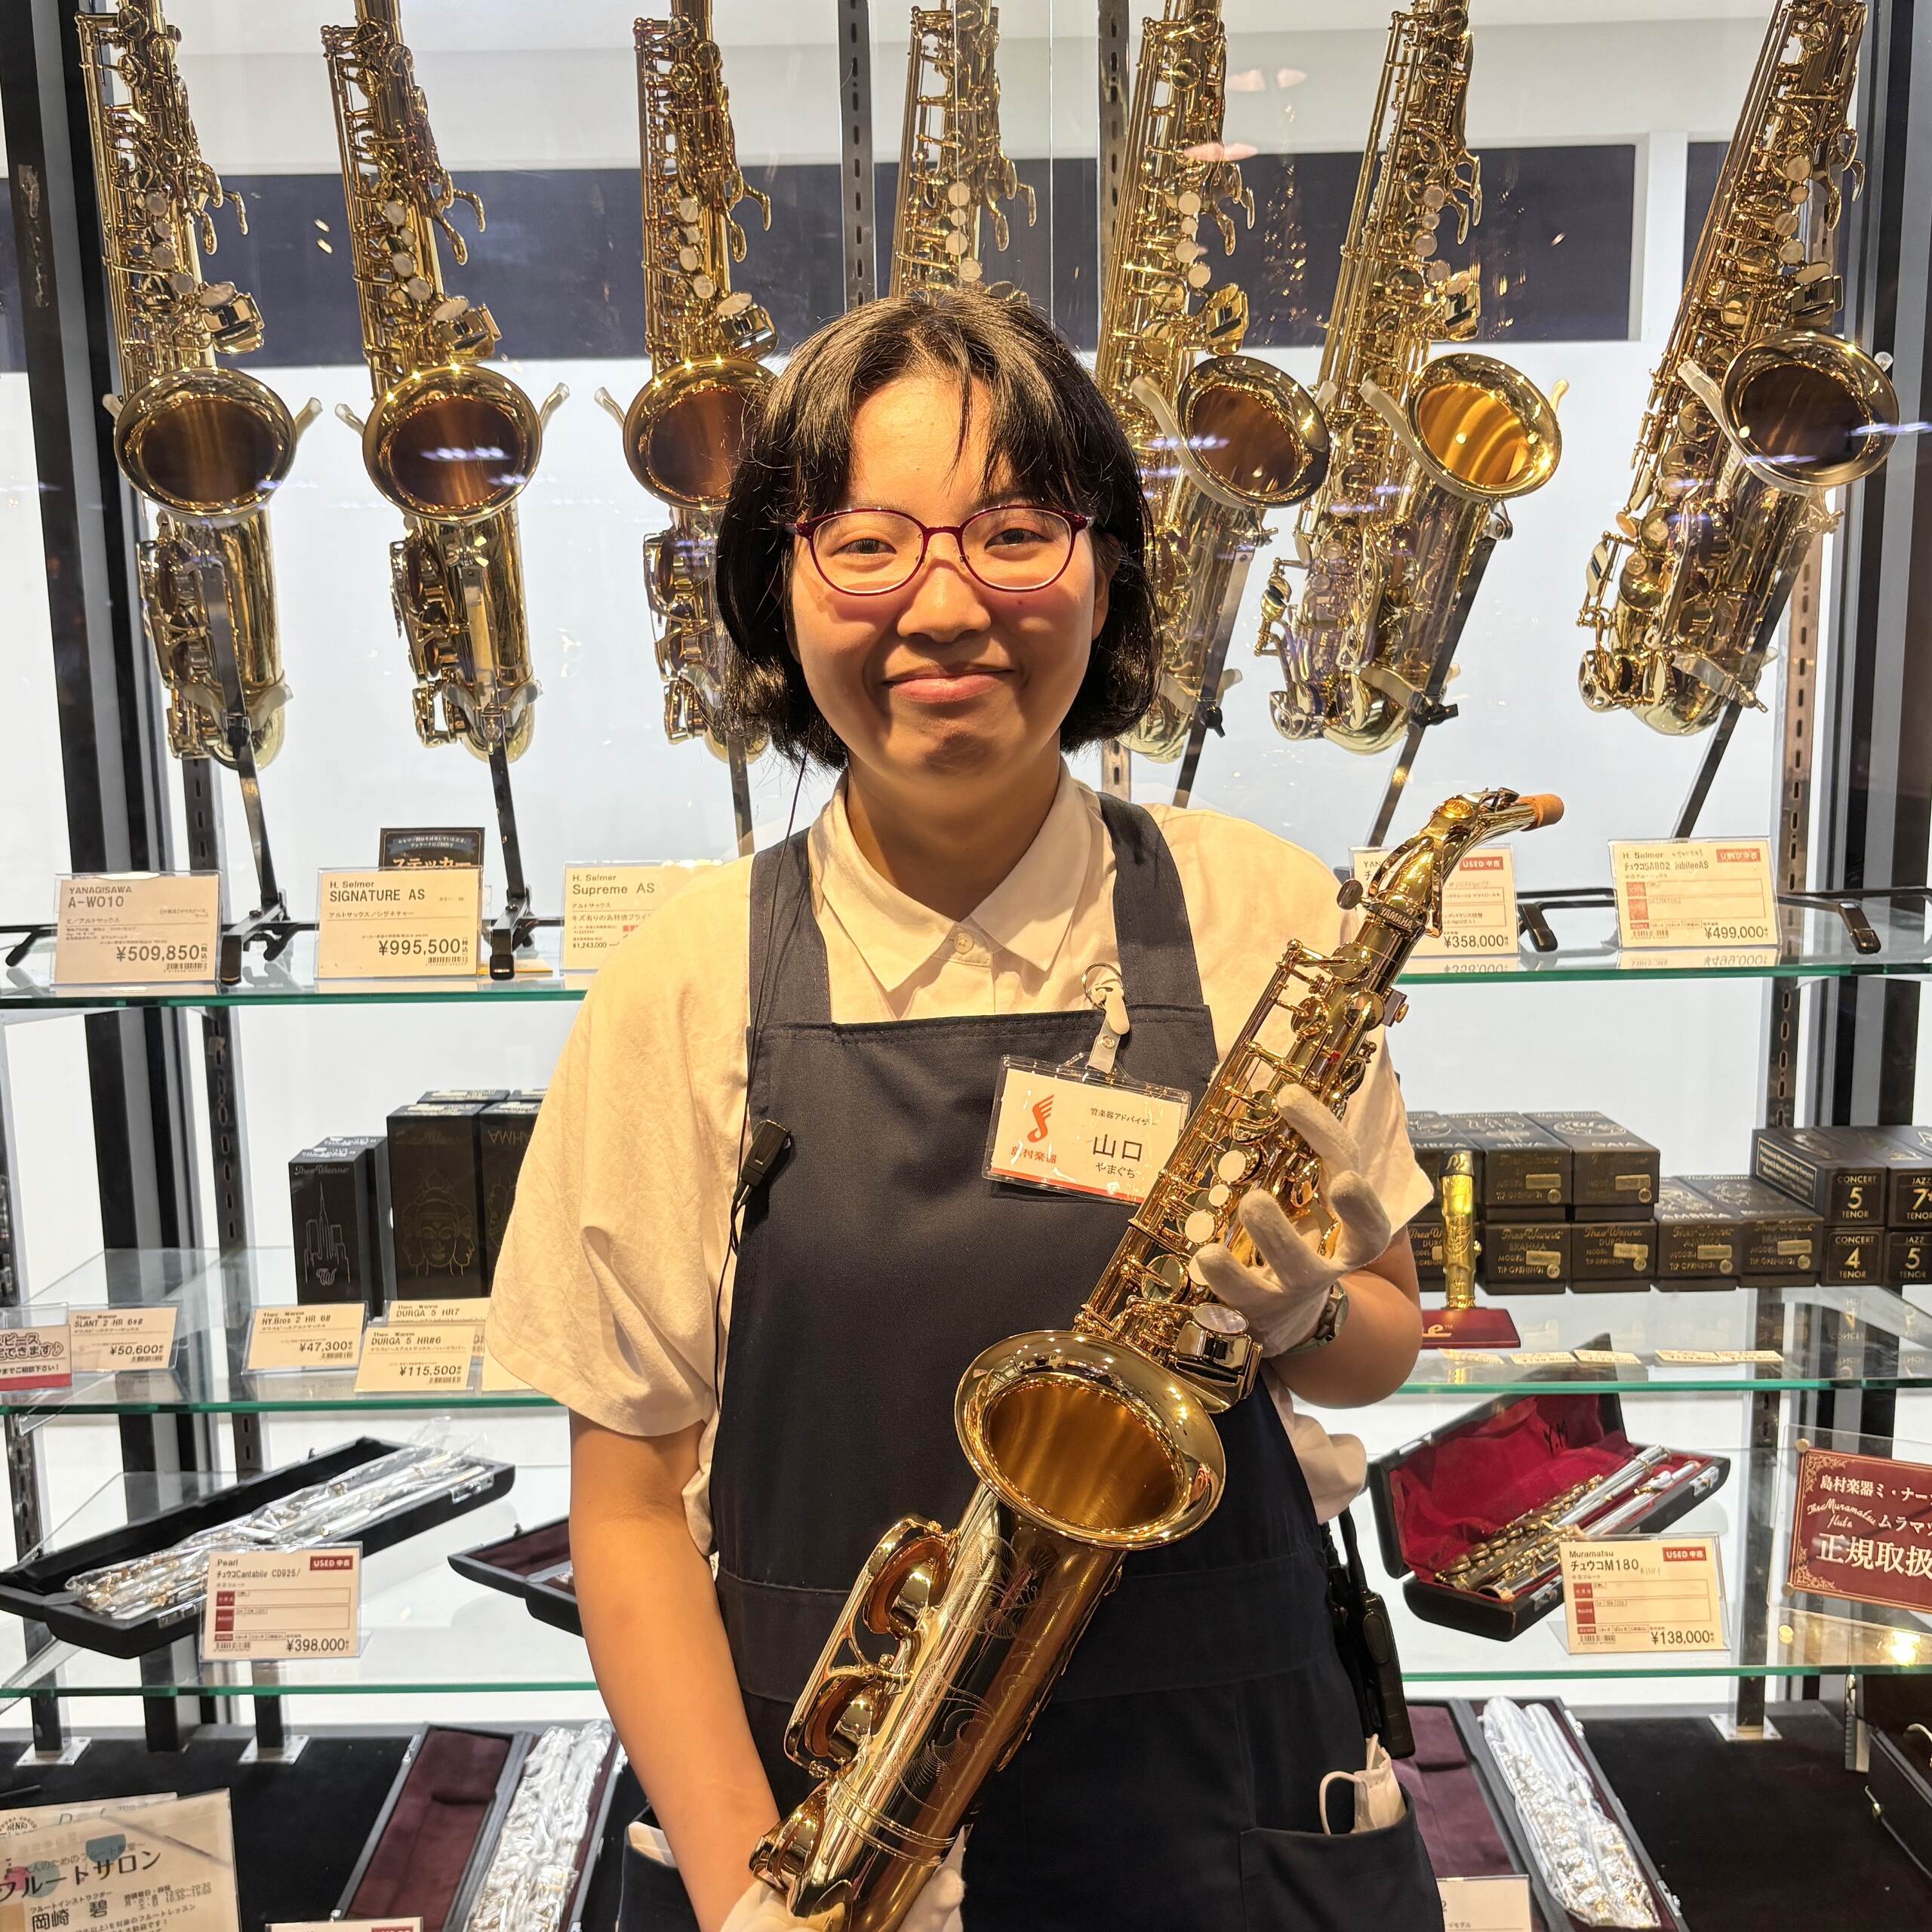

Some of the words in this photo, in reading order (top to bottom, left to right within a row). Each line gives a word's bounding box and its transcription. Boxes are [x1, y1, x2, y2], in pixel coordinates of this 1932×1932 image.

[69, 886, 132, 895] YANAGISAWA
[330, 881, 339, 889] H.
[343, 881, 375, 889] Selmer
[572, 884, 628, 897] Supreme
[636, 882, 655, 894] AS
[330, 889, 401, 903] SIGNATURE
[408, 888, 426, 900] AS
[1380, 907, 1413, 929] YAMAHA
[1704, 925, 1764, 940] ¥499,000
[379, 938, 461, 956] ¥995,500
[1444, 934, 1504, 949] ¥358,000
[117, 944, 199, 962] ¥509,850
[1093, 1134, 1143, 1162] 山口
[1096, 1162, 1135, 1179] やまぐち
[1837, 1175, 1876, 1184] CONCERT
[1912, 1177, 1931, 1185] JAZZ
[1847, 1186, 1863, 1210] 5
[1841, 1210, 1869, 1220] TENOR
[1835, 1235, 1875, 1244] CONCERT
[1906, 1235, 1924, 1244] JAZZ
[1844, 1247, 1860, 1269] 4
[1905, 1247, 1921, 1269] 5
[1839, 1270, 1866, 1278] TENOR
[1900, 1270, 1926, 1278] TENOR
[305, 1315, 316, 1323] HR
[396, 1309, 426, 1318] DURGA
[441, 1308, 460, 1316] HR7
[75, 1318, 98, 1328] SLANT
[300, 1340, 348, 1352] ¥47,300
[371, 1337, 401, 1346] DURGA
[406, 1337, 411, 1345] 5
[417, 1336, 441, 1345] HR#6
[110, 1344, 159, 1355] ¥50,600
[399, 1365, 457, 1377] ¥115,500
[1820, 1474, 1932, 1507] 島村楽器ミ・ナー
[1569, 1550, 1614, 1558] Muramatsu
[1666, 1551, 1688, 1559] USED
[1816, 1533, 1932, 1580] 正規取扱
[217, 1558, 238, 1567] Pearl
[313, 1559, 335, 1567] USED
[1571, 1558, 1639, 1572] チュウコM180
[1651, 1630, 1710, 1645] ¥138,000
[287, 1638, 346, 1652] ¥398,000
[0, 1850, 162, 1903] フルートサロン
